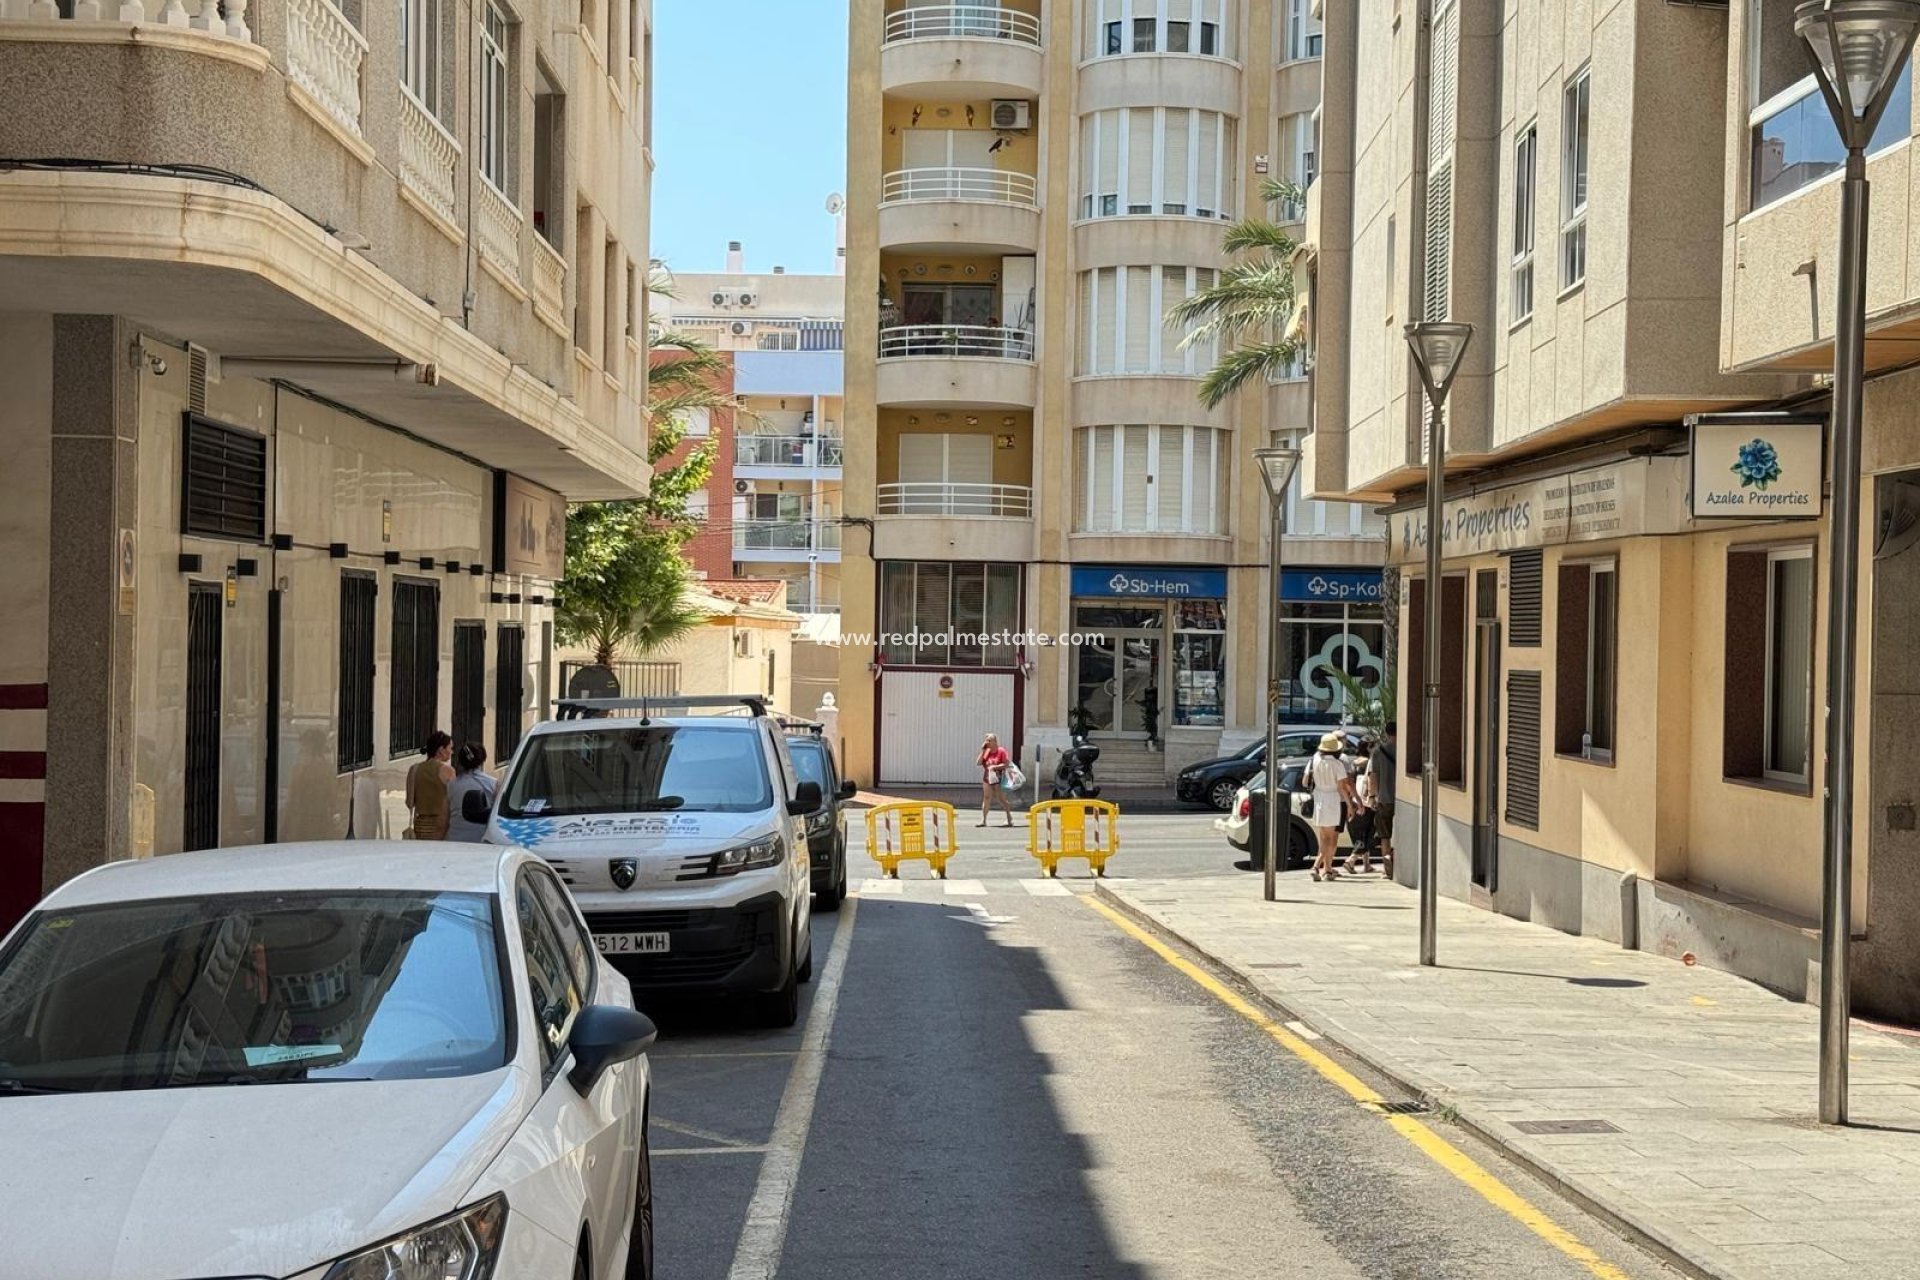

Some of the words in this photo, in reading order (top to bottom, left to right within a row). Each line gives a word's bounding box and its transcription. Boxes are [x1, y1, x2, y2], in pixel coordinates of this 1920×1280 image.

[1706, 490, 1744, 504] Azalea
[1749, 490, 1809, 509] Properties
[1456, 493, 1529, 550] Properties
[1130, 579, 1190, 594] Sb-Hem
[634, 934, 666, 951] MWH
